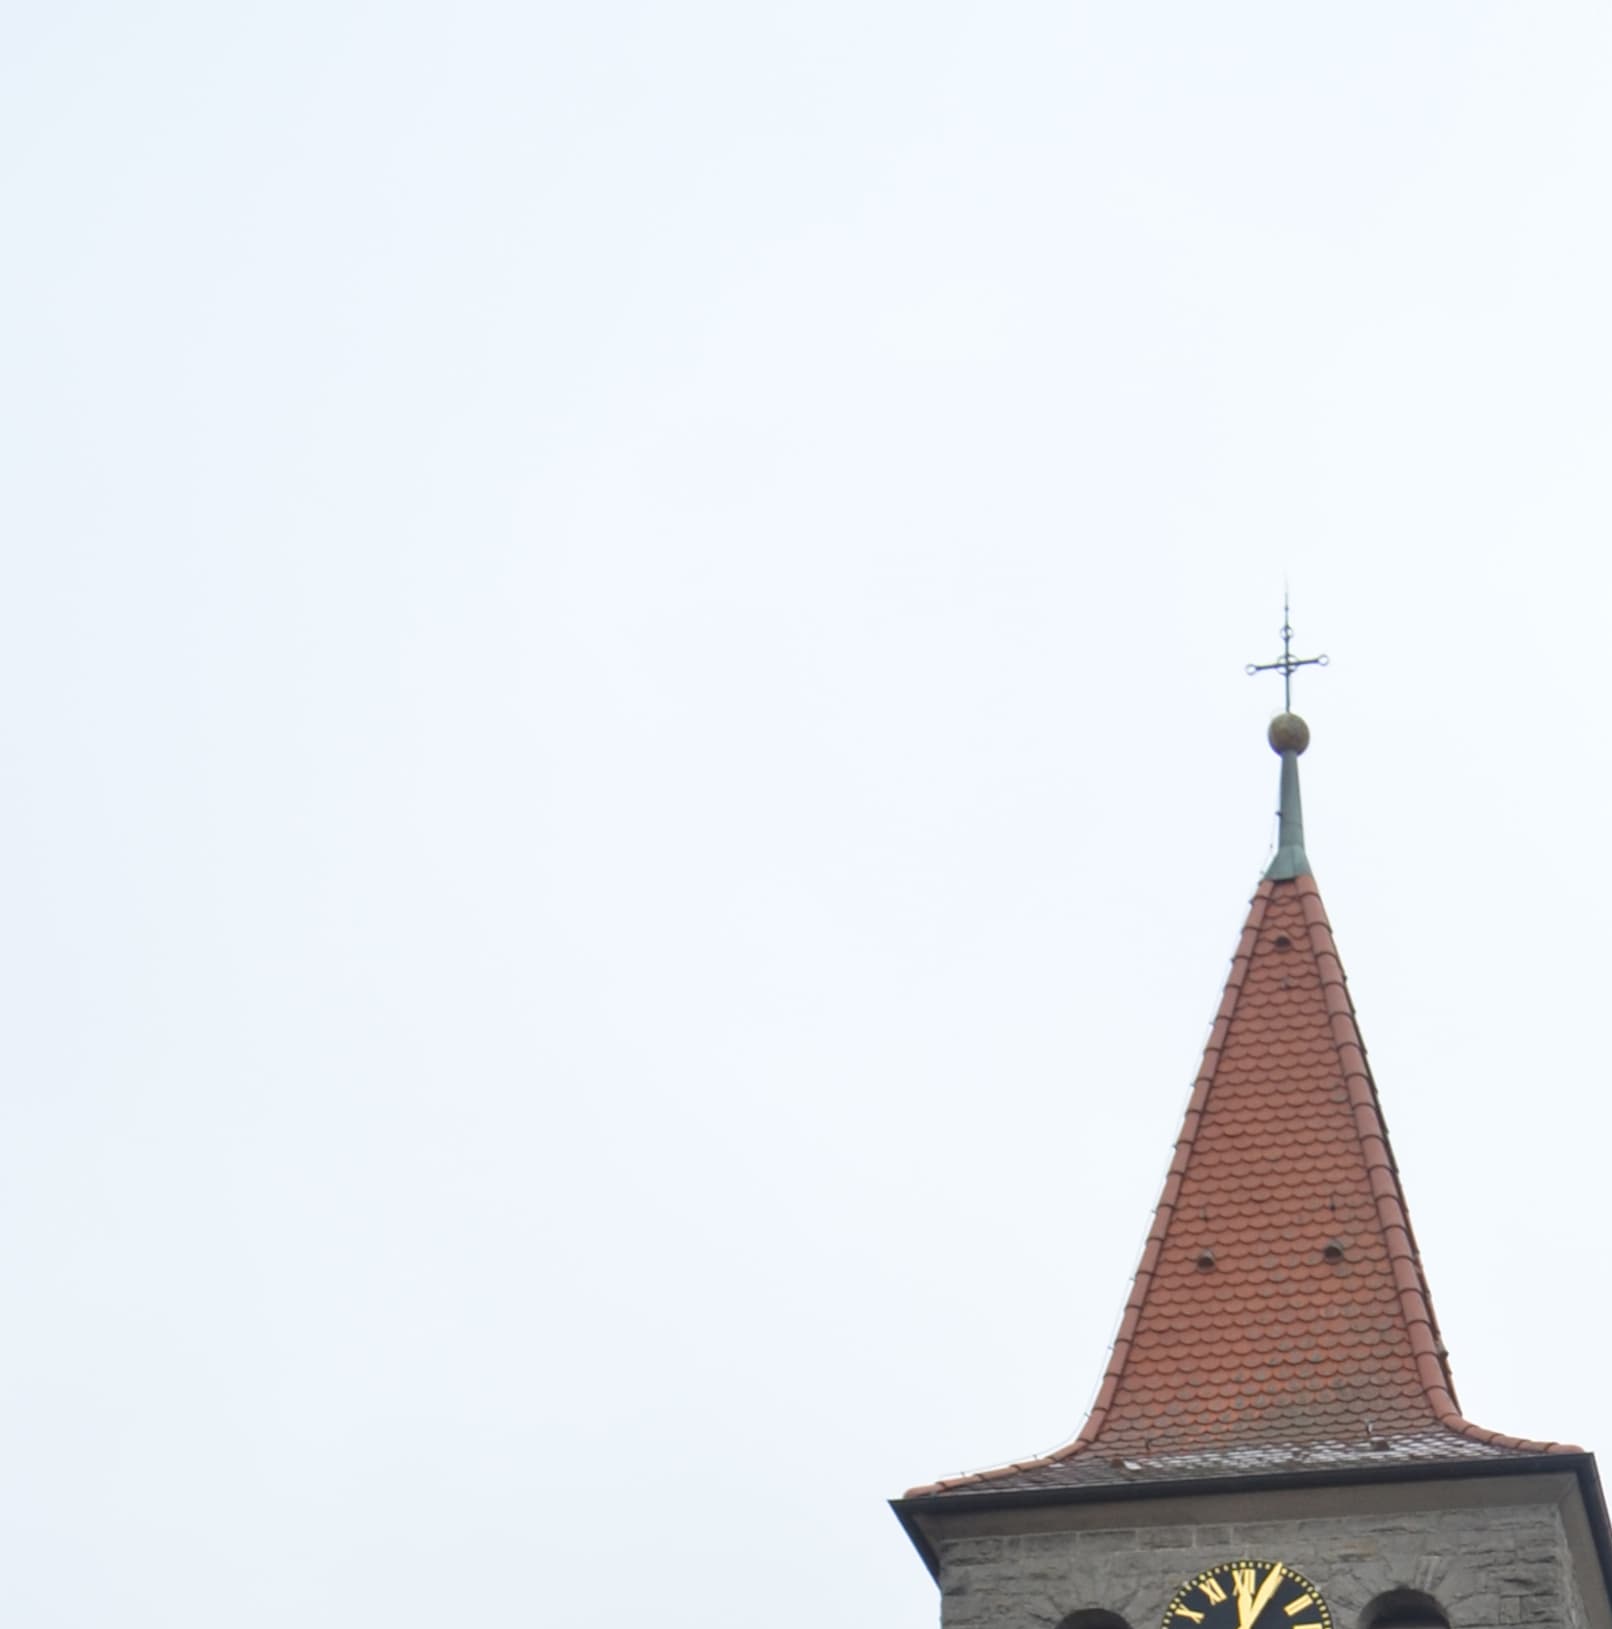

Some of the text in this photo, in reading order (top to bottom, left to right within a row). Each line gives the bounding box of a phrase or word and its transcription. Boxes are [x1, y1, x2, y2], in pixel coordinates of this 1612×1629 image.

[1199, 1577, 1228, 1605] XI
[1174, 1604, 1205, 1624] X
[1284, 1594, 1313, 1616] II
